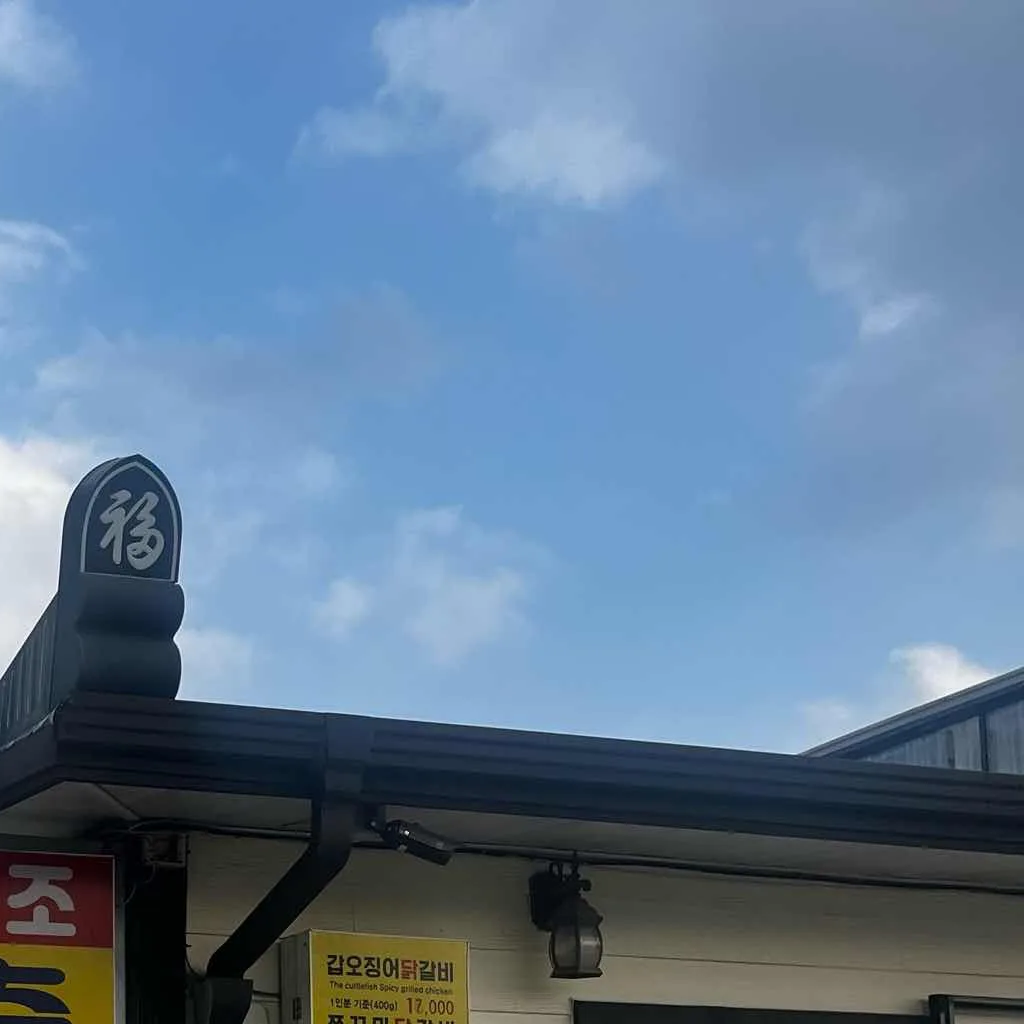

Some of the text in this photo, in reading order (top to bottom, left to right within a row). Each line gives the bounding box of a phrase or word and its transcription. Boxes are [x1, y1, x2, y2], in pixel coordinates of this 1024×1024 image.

[100, 489, 165, 570] 福
[330, 981, 343, 989] The
[379, 984, 399, 993] Spicy
[406, 998, 455, 1015] 17,000
